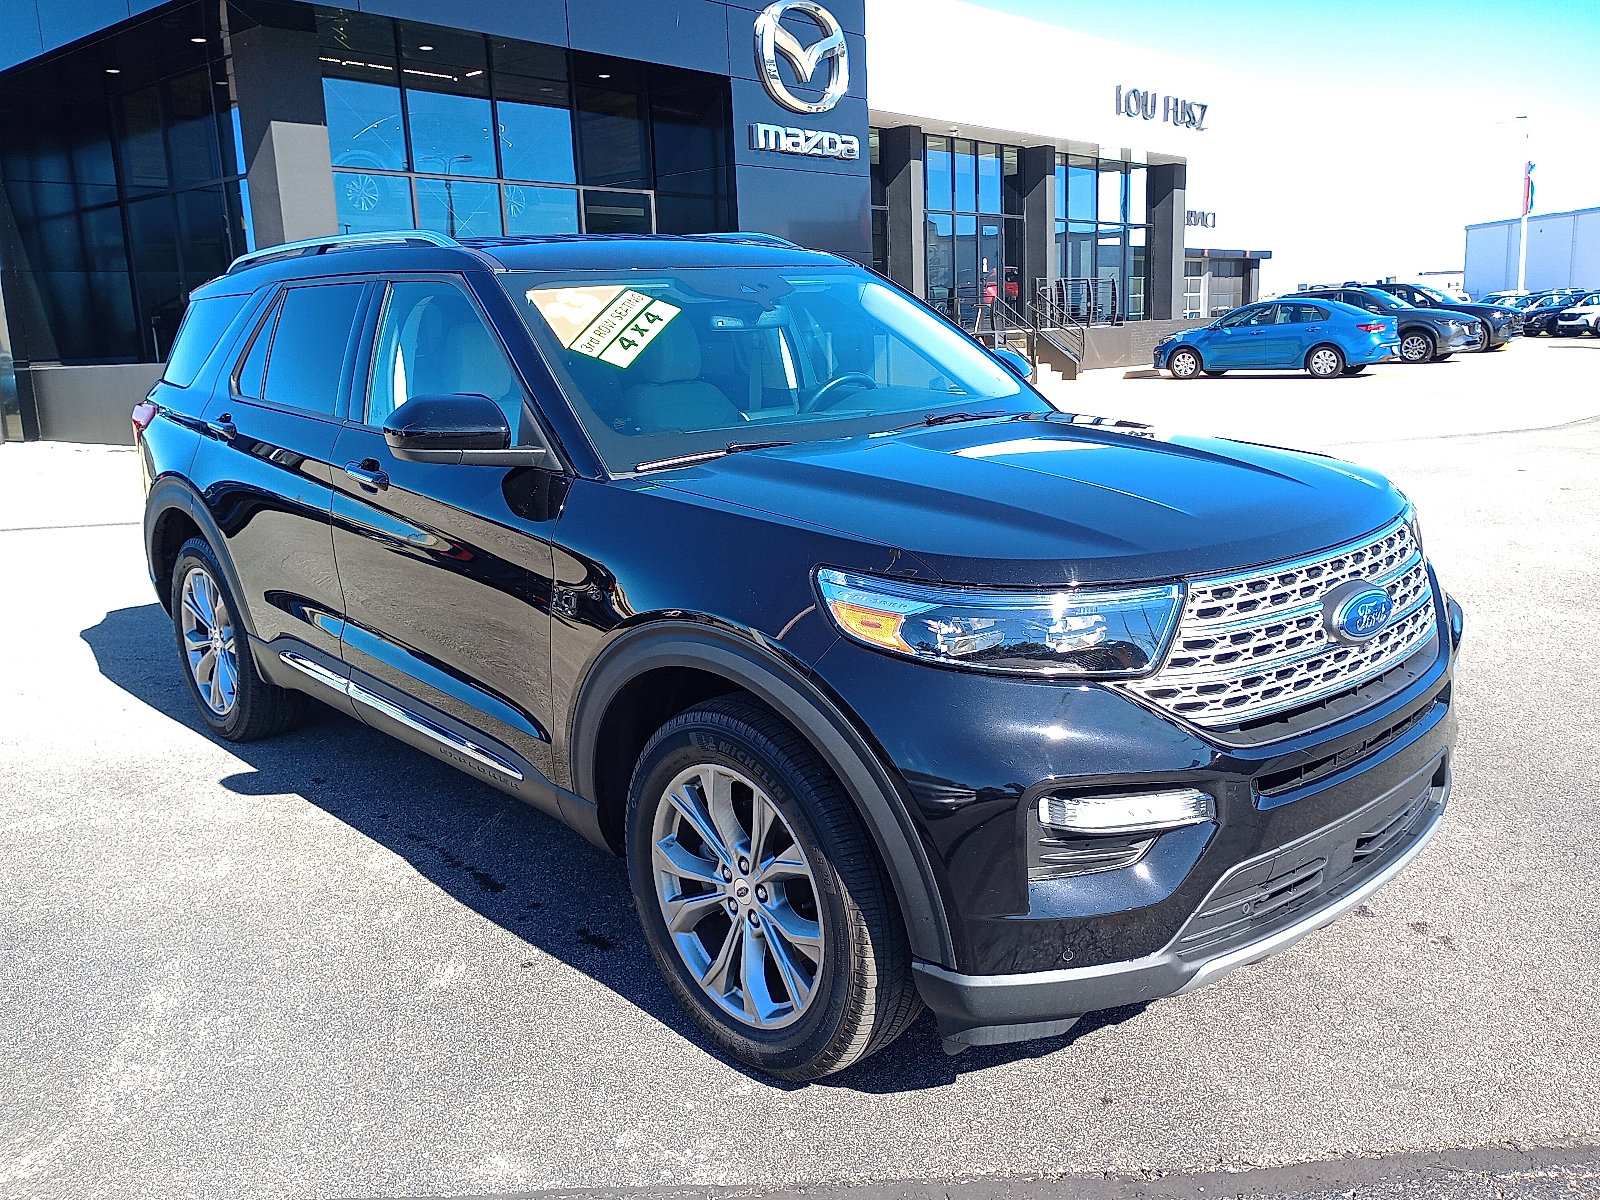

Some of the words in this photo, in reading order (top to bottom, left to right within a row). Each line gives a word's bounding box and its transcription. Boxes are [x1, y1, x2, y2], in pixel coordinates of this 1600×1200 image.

[1115, 84, 1157, 121] LOU
[1162, 95, 1209, 131] FUSZ
[748, 122, 860, 160] mazda
[580, 336, 601, 353] 3rd
[593, 318, 617, 339] ROW
[611, 293, 644, 321] SEATING
[619, 336, 639, 351] 4
[644, 311, 664, 324] 4
[1356, 600, 1387, 632] Ford
[719, 740, 786, 798] MICHELIN
